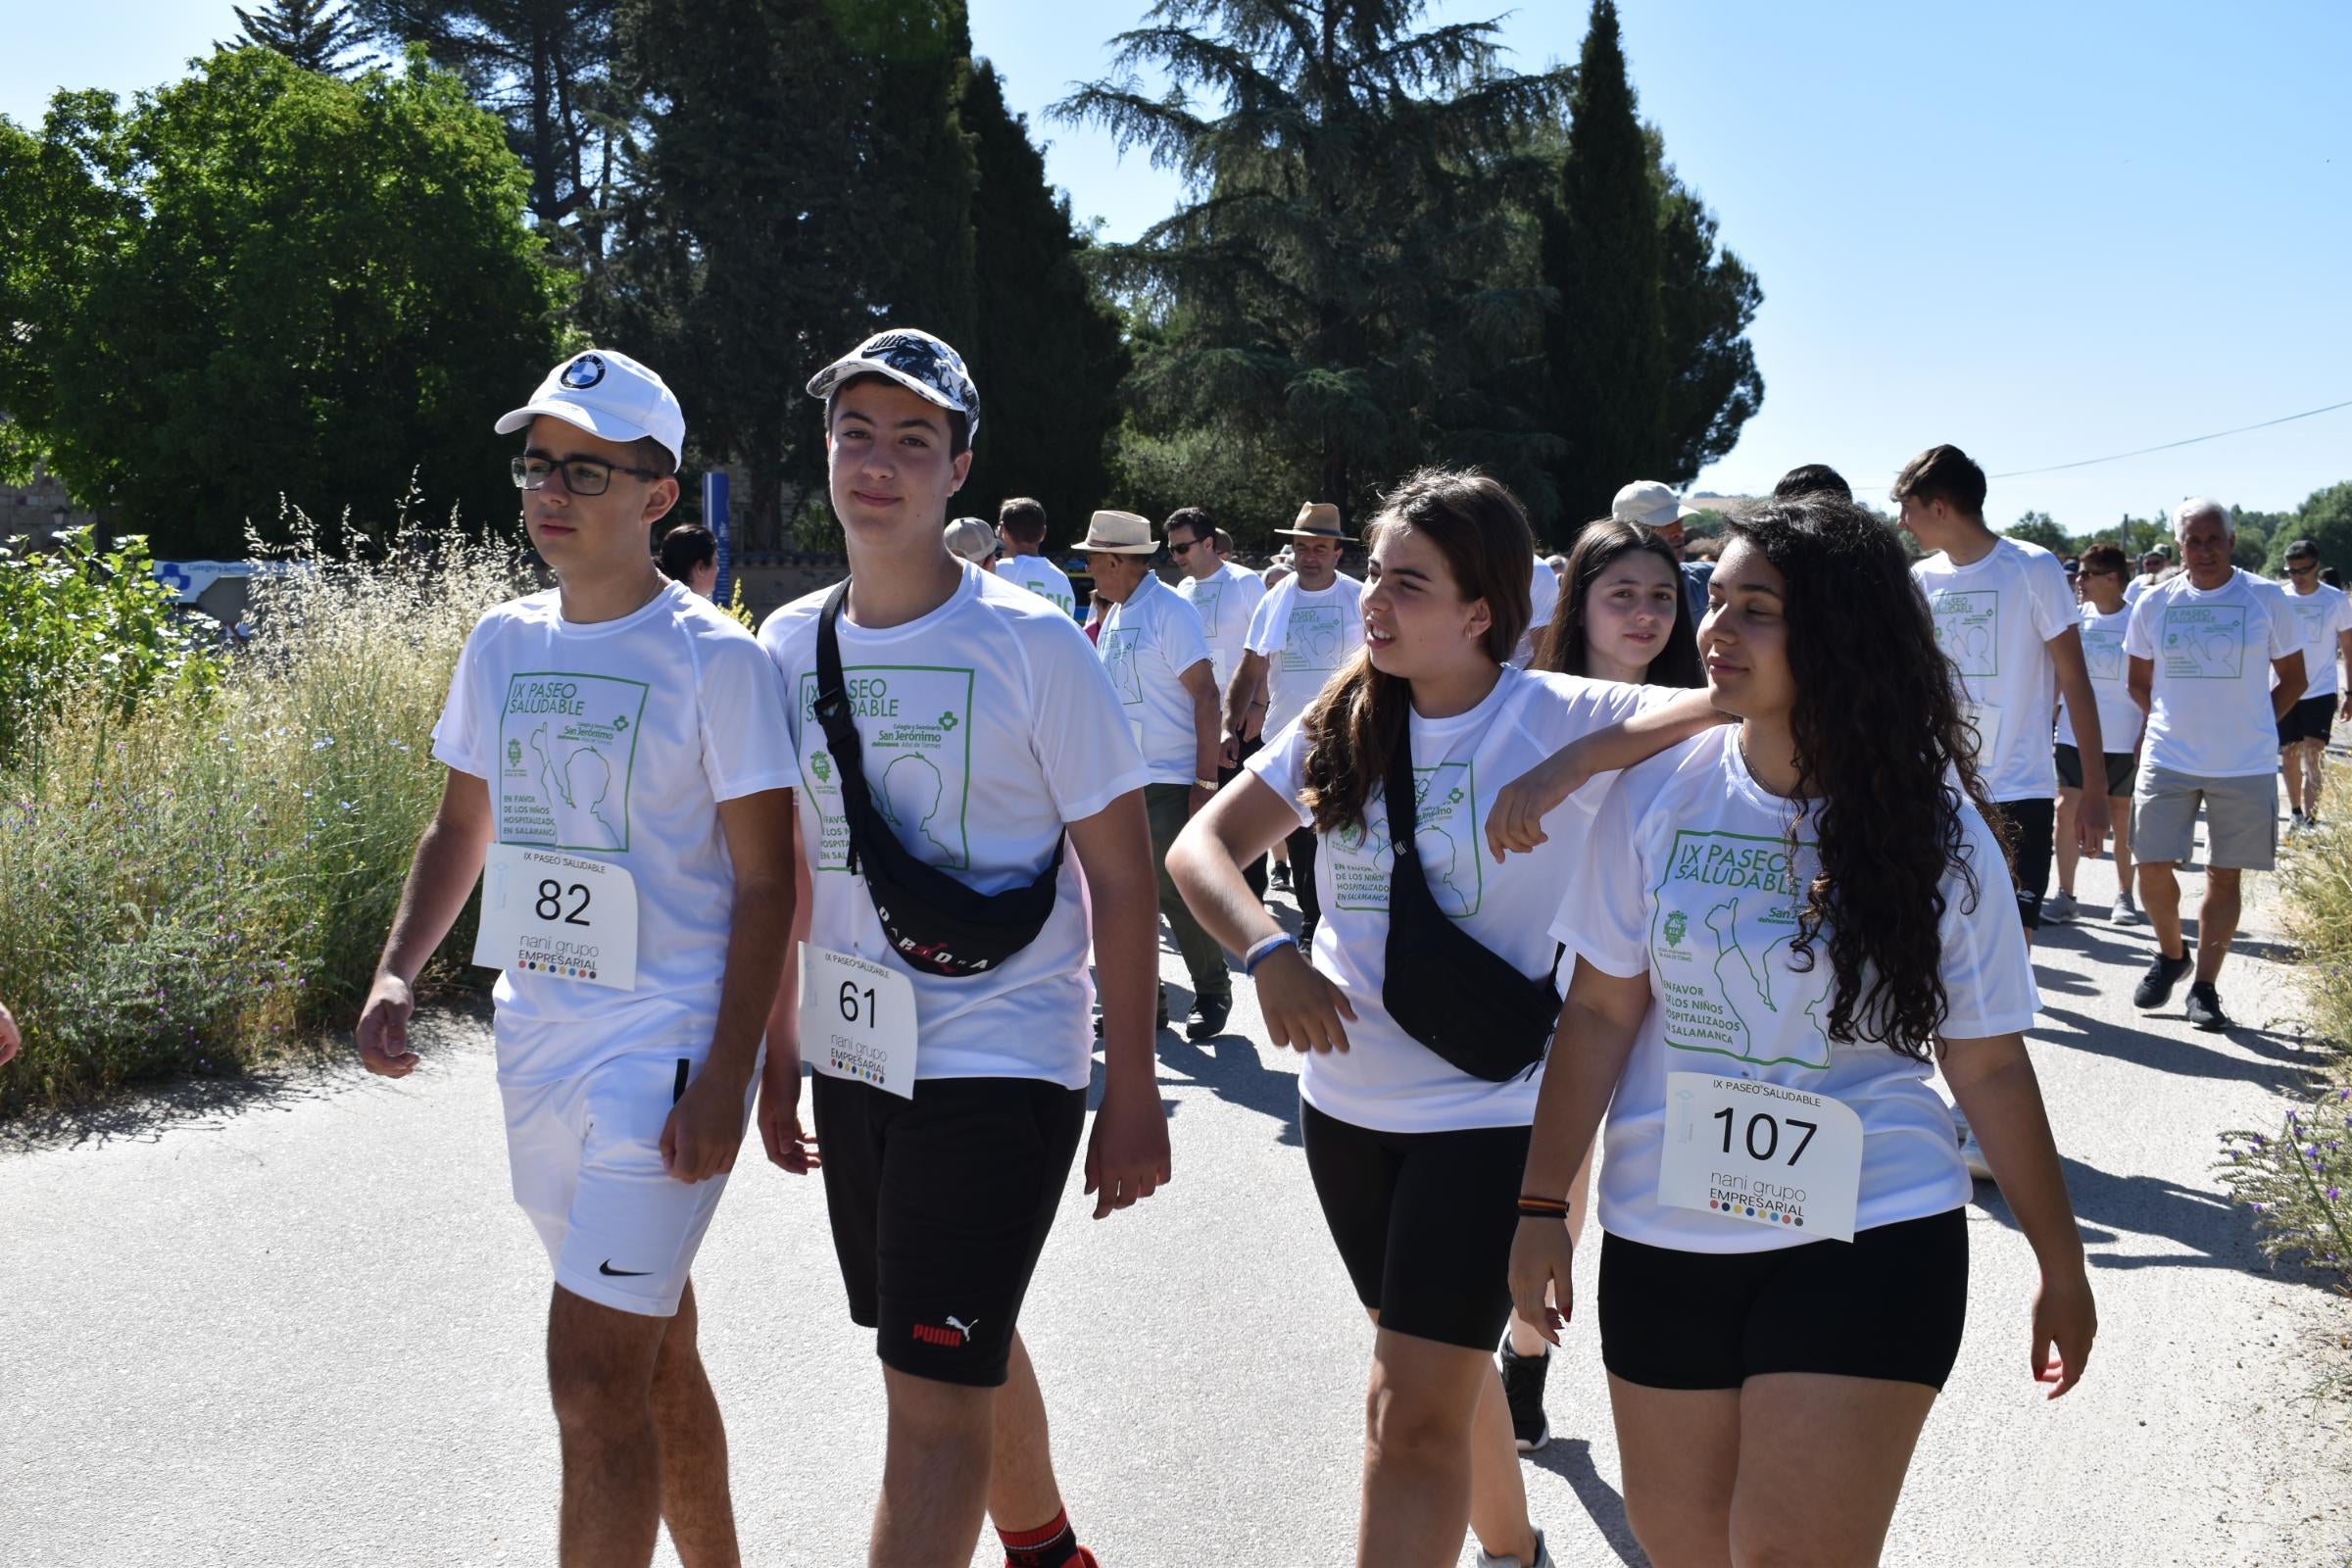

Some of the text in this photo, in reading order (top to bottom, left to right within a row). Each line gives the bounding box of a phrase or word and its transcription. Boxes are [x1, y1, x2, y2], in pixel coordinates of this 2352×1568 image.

[512, 682, 577, 699] IX PASEO
[510, 699, 585, 716] SALUDABLE
[564, 725, 578, 735] San
[879, 730, 942, 742] San Jerónimo
[523, 852, 607, 874] IX PASEO SALUDABLE
[1680, 844, 1791, 873] IX PASEO
[1675, 864, 1803, 898] SALUDABLE
[535, 879, 591, 926] 82
[1768, 906, 1790, 919] San
[519, 935, 600, 958] nani grupo
[518, 949, 598, 971] EMPRESARIAL
[833, 955, 857, 967] PASEO
[857, 959, 891, 979] SALUDABLE
[1672, 983, 1704, 997] FAVOR
[840, 980, 875, 1029] 61
[1672, 998, 1689, 1008] LOS
[1691, 1000, 1724, 1014] NIÑOS
[1671, 1024, 1734, 1045] SALAMANCA
[831, 1034, 888, 1063] nani grupo
[831, 1048, 886, 1076] EMPRESARIAL
[1713, 1079, 1822, 1107] IX PASEO SALUDABLE
[1714, 1107, 1817, 1166] 107
[1711, 1171, 1807, 1203] nani grupo
[1709, 1187, 1805, 1218] EMPRESARIAL
[912, 1323, 961, 1348] PUMA
